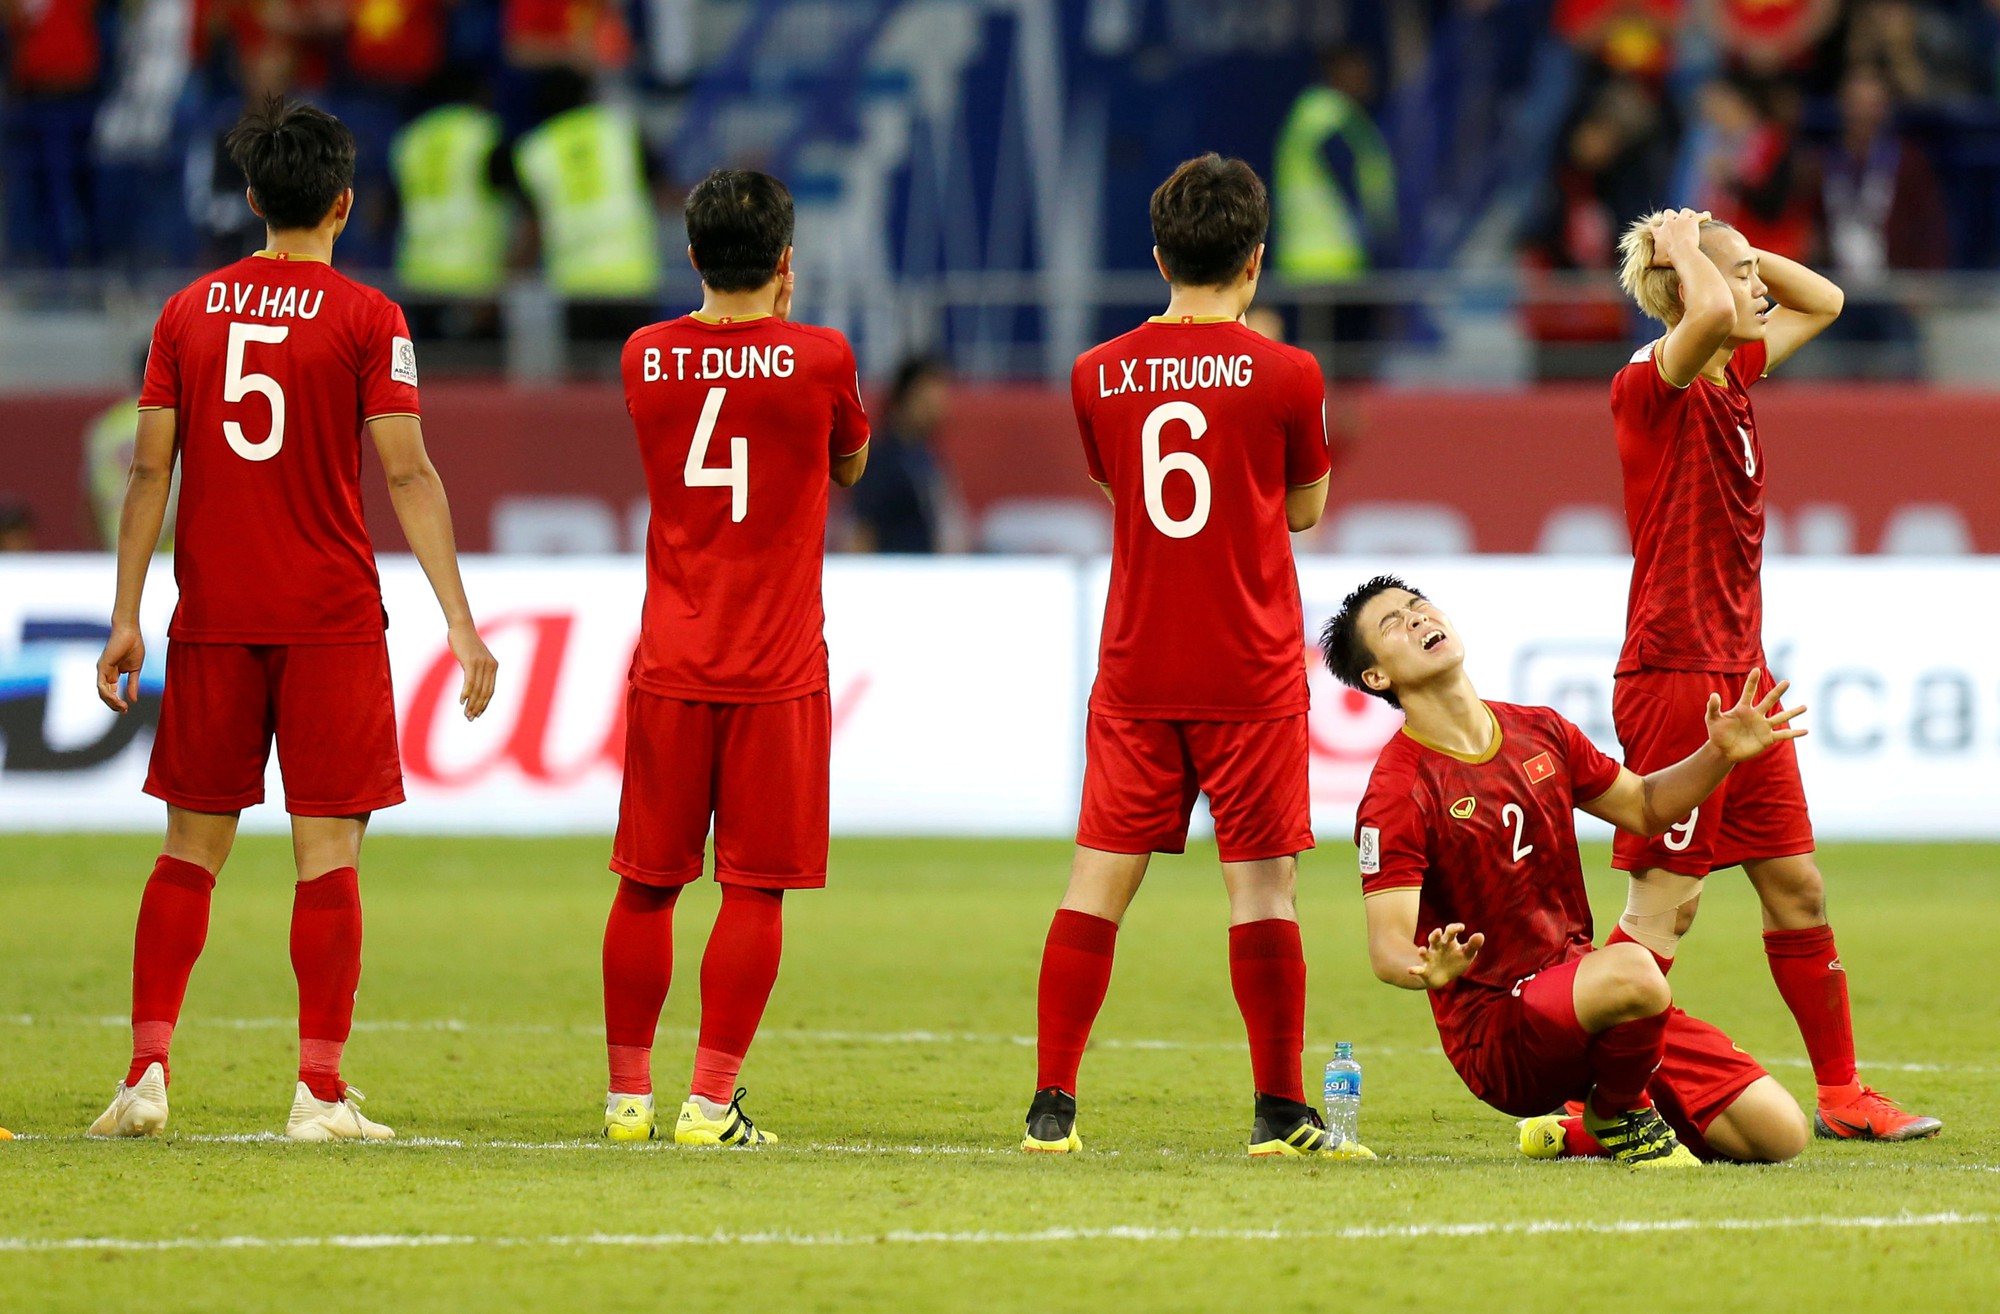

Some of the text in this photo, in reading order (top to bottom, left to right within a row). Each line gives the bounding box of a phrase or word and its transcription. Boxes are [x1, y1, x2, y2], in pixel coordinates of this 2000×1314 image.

[206, 281, 324, 320] D.V.HAU
[222, 321, 289, 462] 5
[643, 344, 795, 382] B.T.DUNG
[1099, 354, 1253, 398] L.X.TRUONG
[684, 387, 748, 523] 4
[1141, 400, 1211, 539] 6
[1502, 803, 1534, 863] 2
